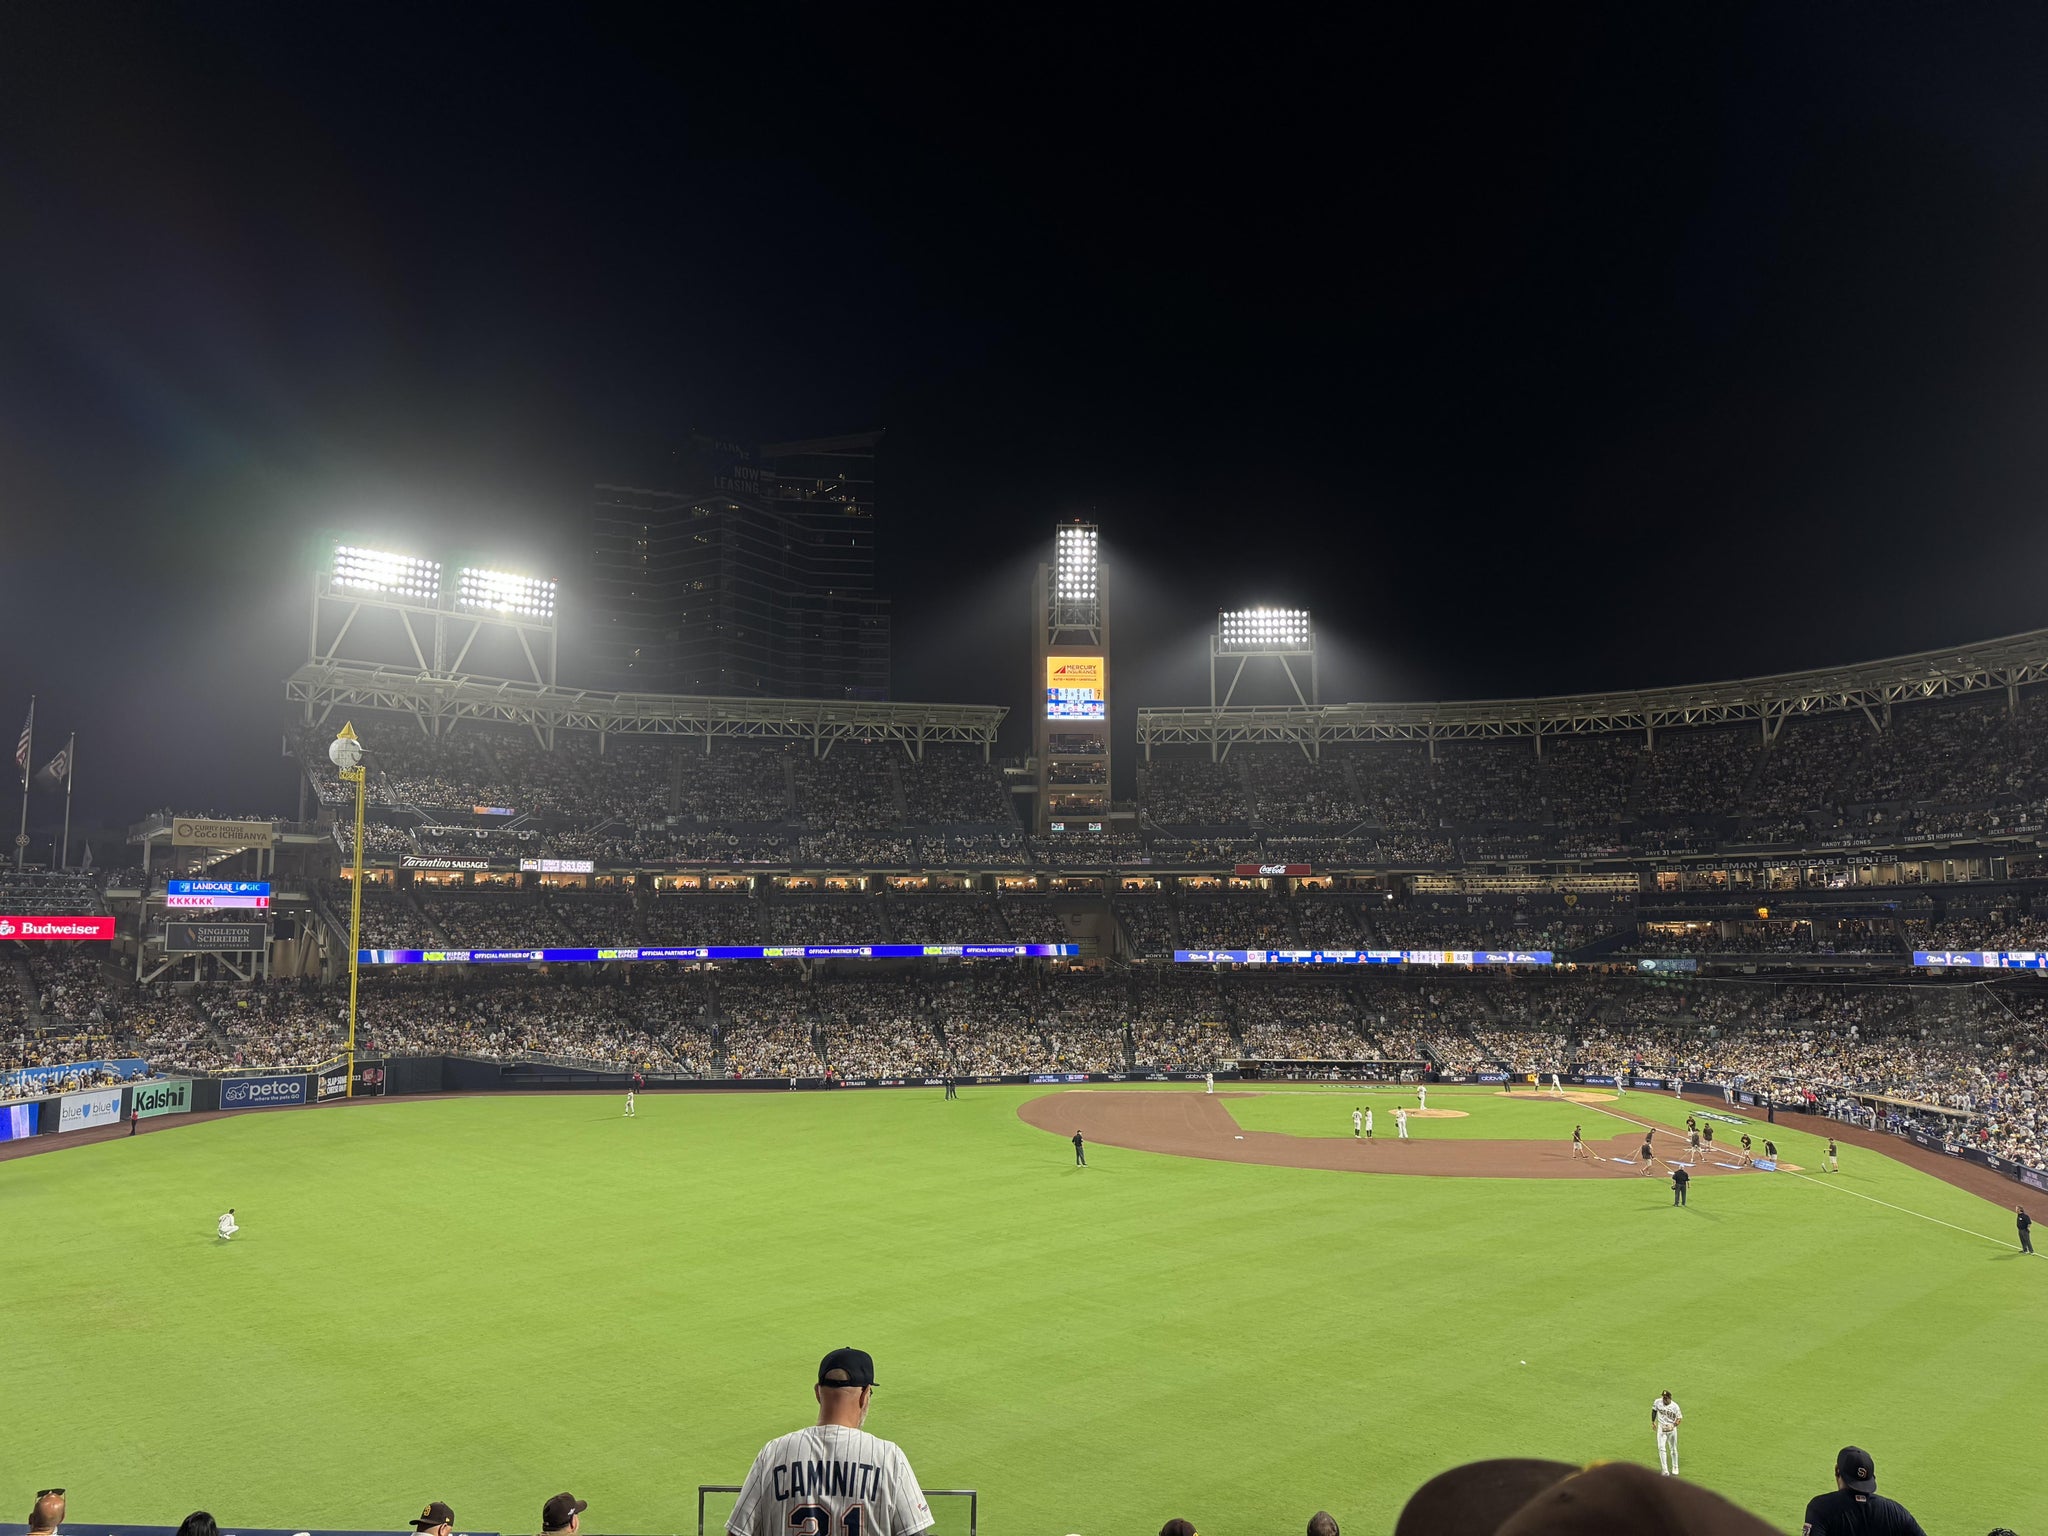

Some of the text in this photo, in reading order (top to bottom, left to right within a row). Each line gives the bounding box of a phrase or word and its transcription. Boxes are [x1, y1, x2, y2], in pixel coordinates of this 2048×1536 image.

[735, 466, 759, 480] NOW
[714, 476, 759, 494] LEASING
[402, 856, 450, 868] Tarantino
[1696, 862, 1758, 870] COLEMAN
[1763, 858, 1841, 868] BROADCAST
[1847, 855, 1898, 864] CENTER
[22, 922, 99, 934] Budweiser
[328, 1077, 336, 1086] SLAP
[250, 1081, 299, 1099] petco
[327, 1085, 338, 1094] CHEESE
[136, 1087, 184, 1111] Kalshi
[62, 1107, 82, 1118] blue
[92, 1100, 111, 1113] blue
[773, 1460, 880, 1501] CAMINITI
